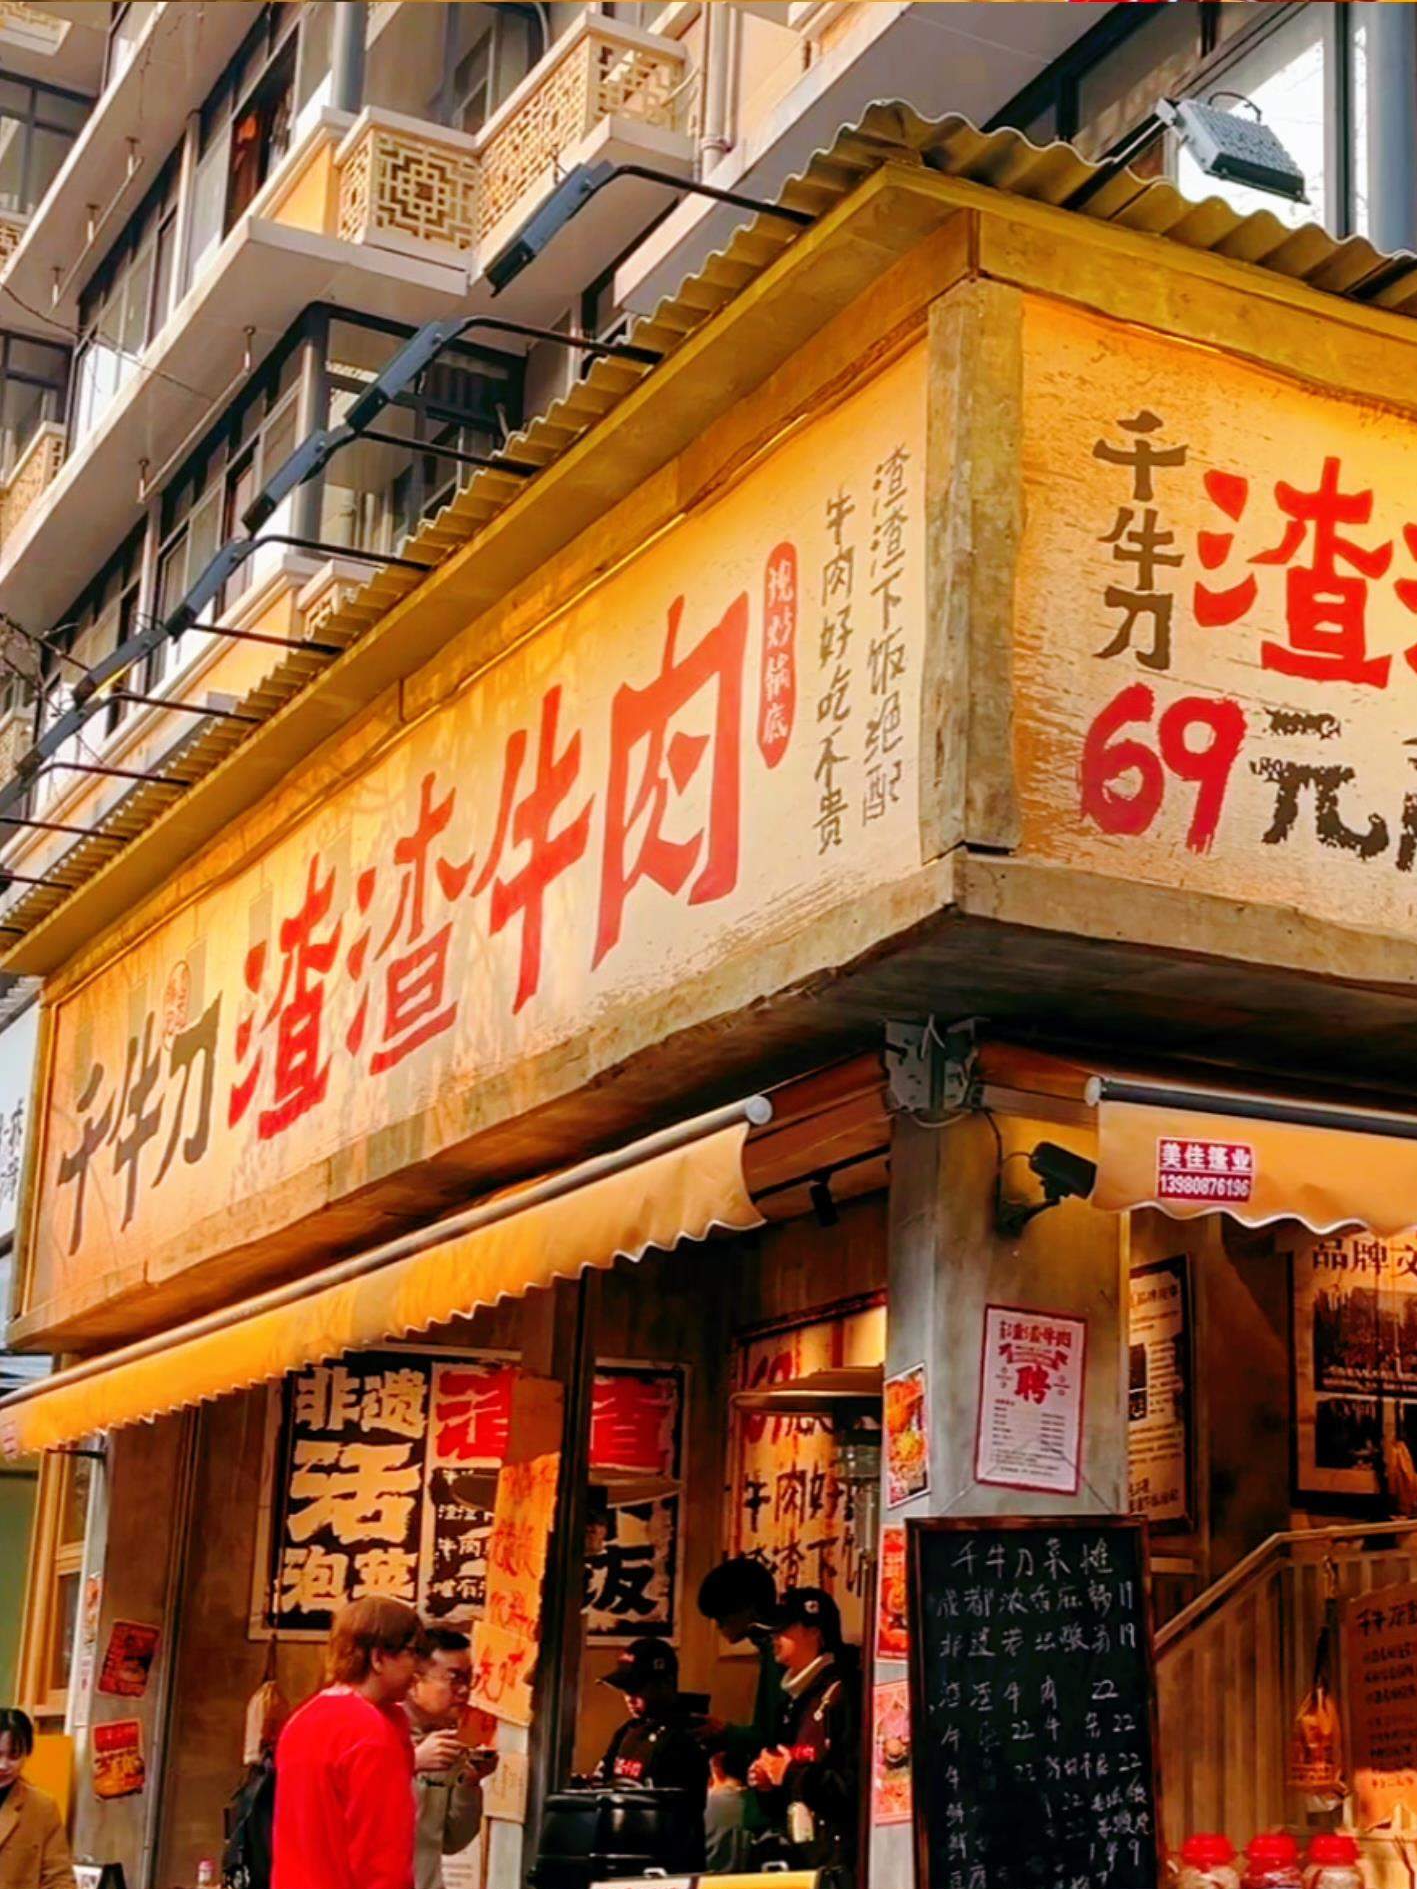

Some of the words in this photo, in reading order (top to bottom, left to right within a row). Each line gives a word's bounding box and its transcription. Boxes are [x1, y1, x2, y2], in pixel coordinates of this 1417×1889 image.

[861, 443, 910, 829] 渣渣下饭绝配
[1092, 410, 1190, 670] 千牛刀
[815, 493, 855, 856] 牛肉好吃不贵
[228, 589, 750, 1141] 渣渣牛肉
[56, 991, 223, 1257] 千牛刀
[295, 1366, 429, 1436] 非遗
[1014, 1365, 1052, 1405] 聘
